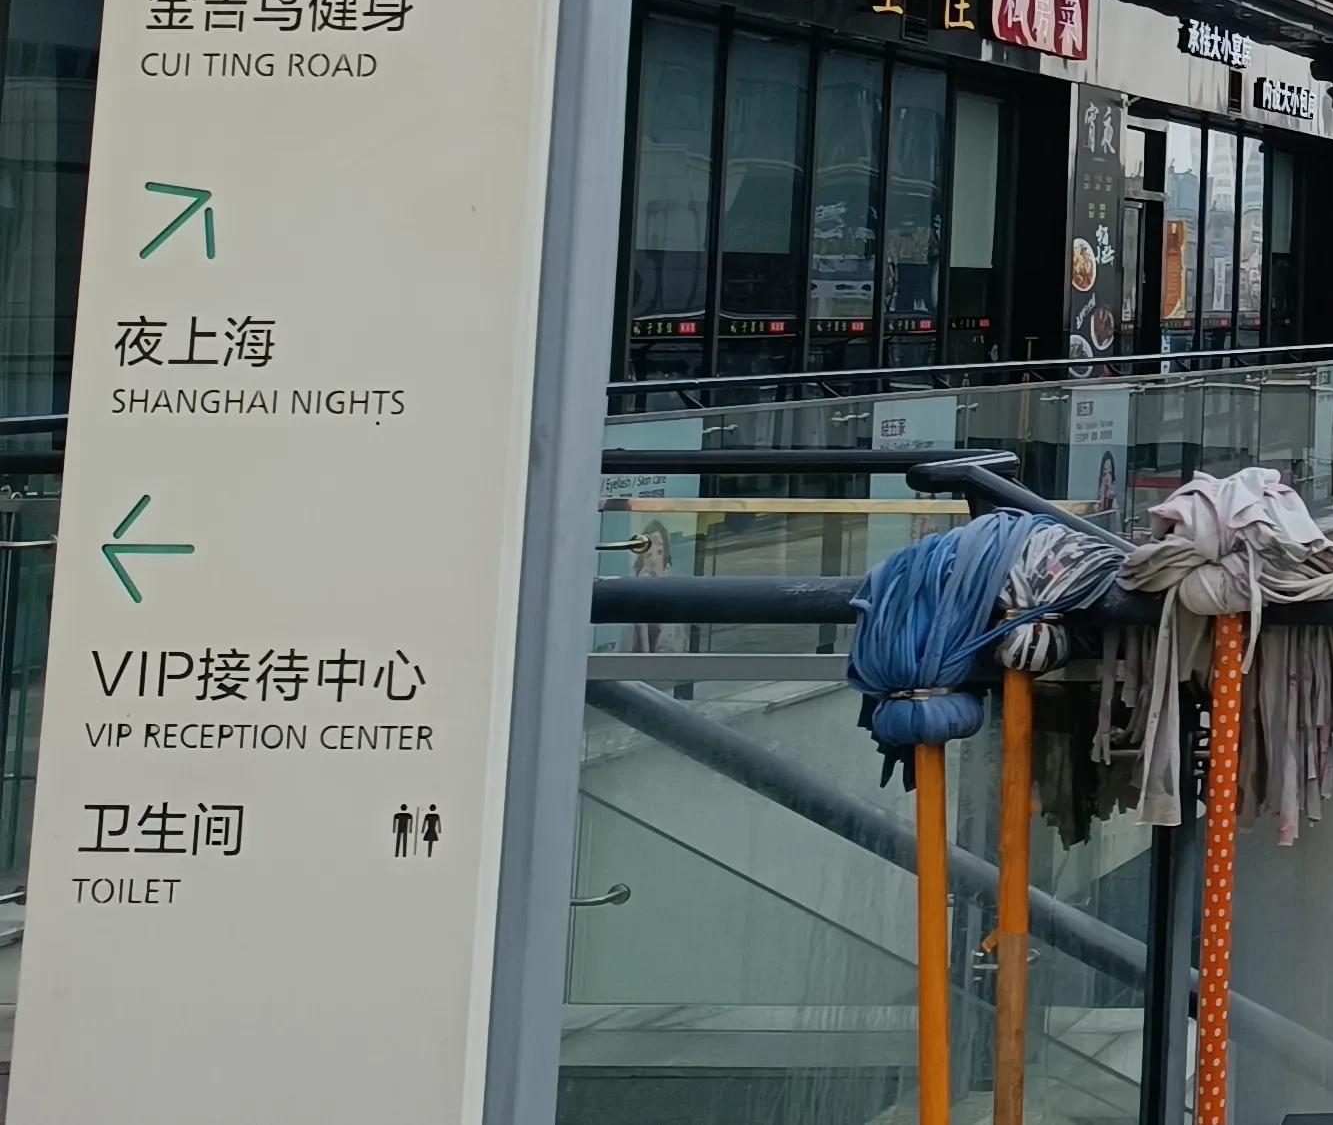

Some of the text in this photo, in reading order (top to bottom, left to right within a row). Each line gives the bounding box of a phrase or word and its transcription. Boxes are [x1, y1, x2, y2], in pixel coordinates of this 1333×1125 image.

[140, 52, 378, 77] CUI TING ROAD
[114, 315, 276, 368] 夜上海
[111, 388, 406, 415] SHANGHAI NIGHTS
[91, 648, 427, 703] VIP接待中心
[85, 722, 434, 750] VIP RECEPTION CENTER
[78, 801, 244, 857] 卫生间
[72, 878, 182, 904] TOILET
